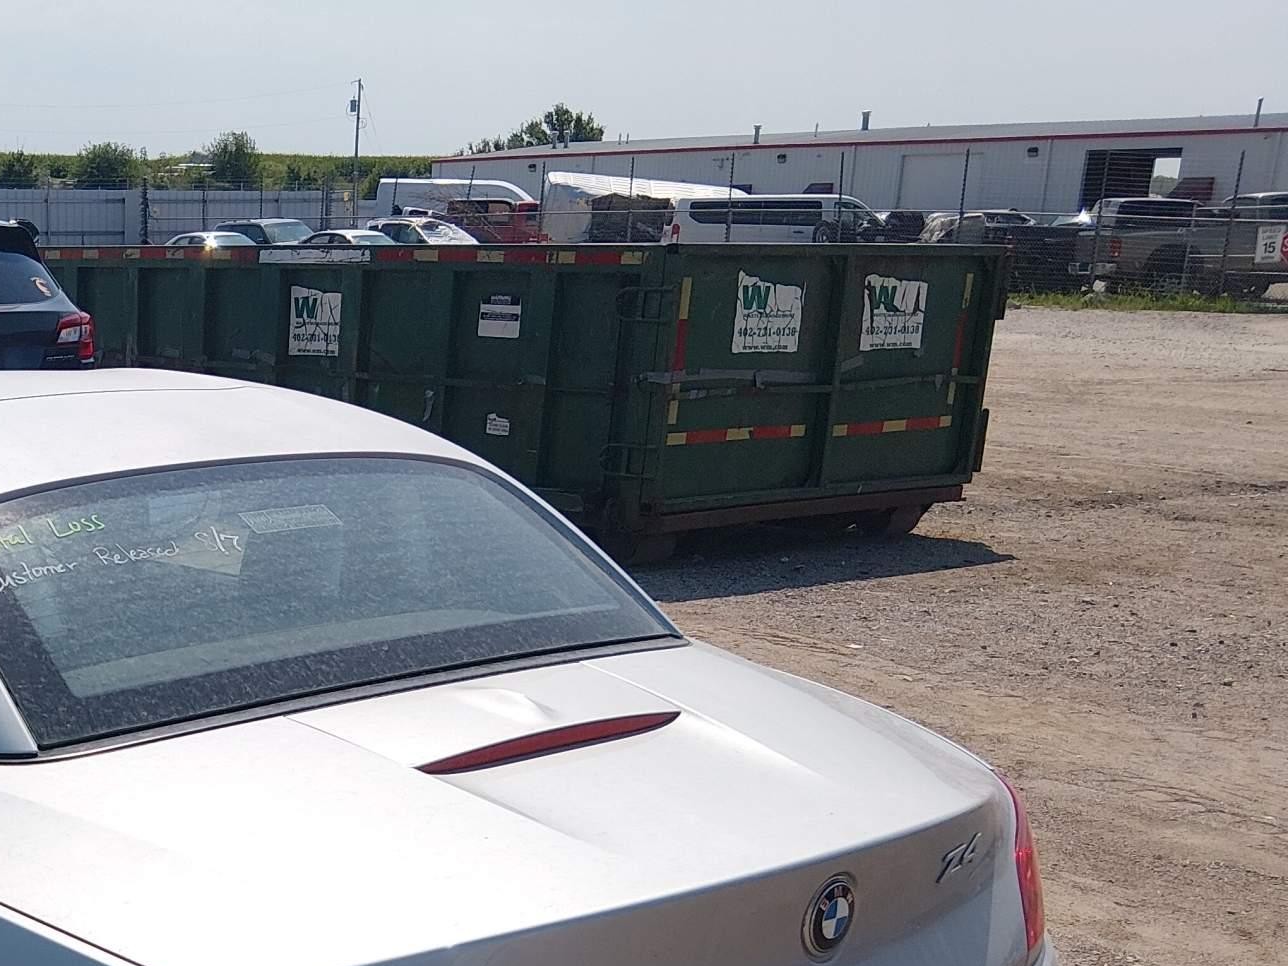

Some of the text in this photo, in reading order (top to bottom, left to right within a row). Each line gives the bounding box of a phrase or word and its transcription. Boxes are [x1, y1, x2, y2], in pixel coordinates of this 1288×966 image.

[1263, 241, 1276, 254] 15
[46, 513, 105, 538] Loss
[93, 541, 180, 566] Released
